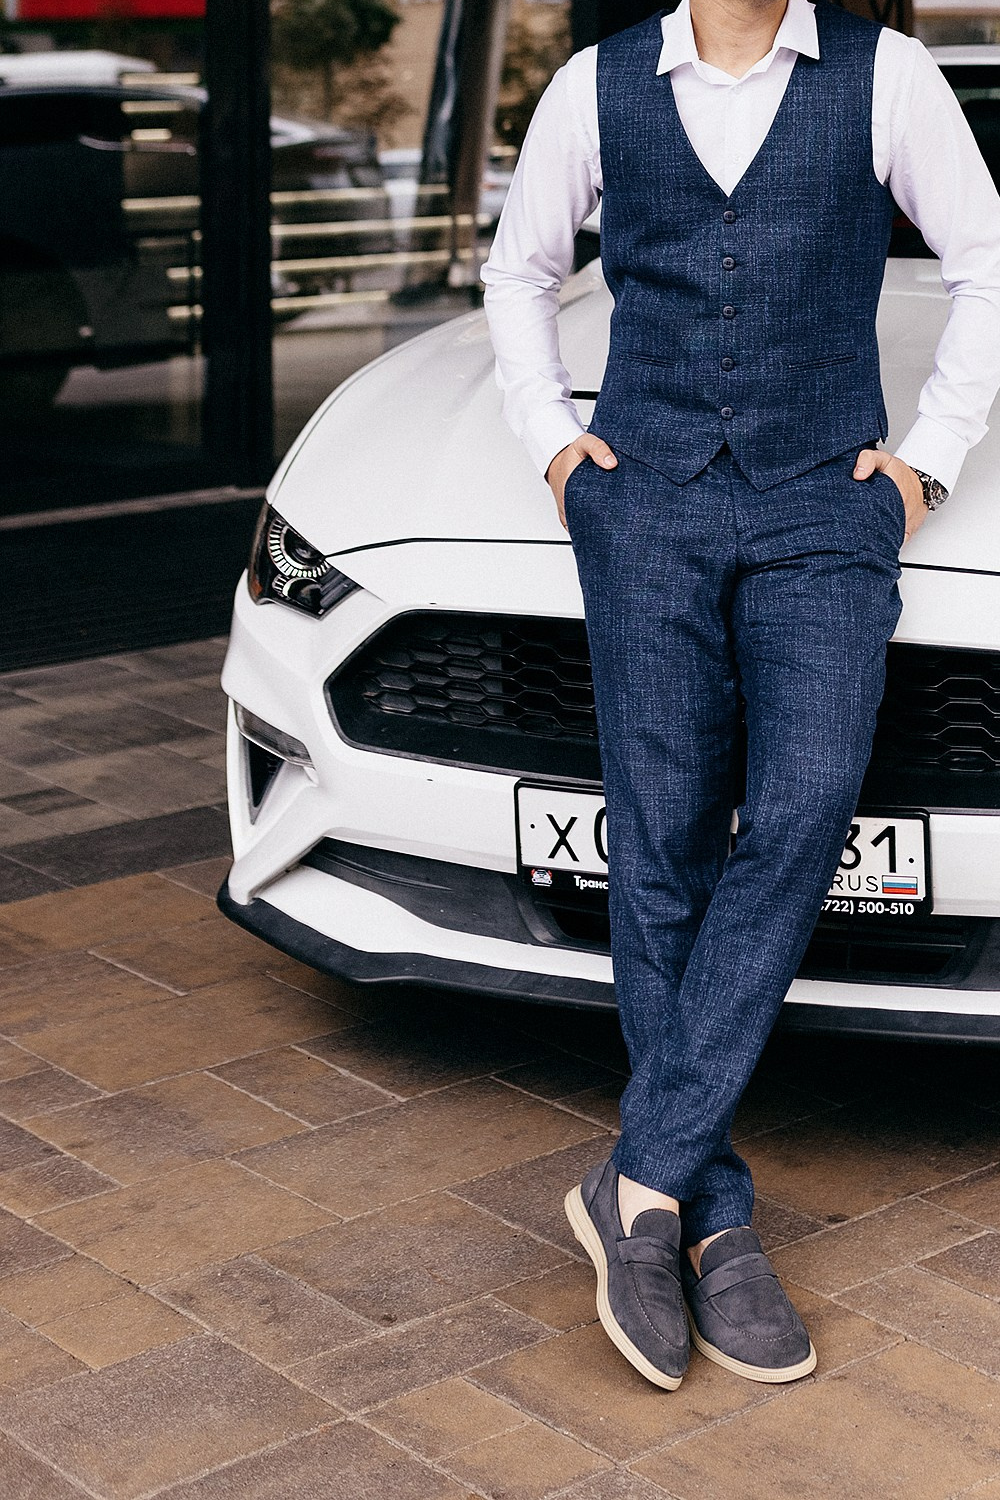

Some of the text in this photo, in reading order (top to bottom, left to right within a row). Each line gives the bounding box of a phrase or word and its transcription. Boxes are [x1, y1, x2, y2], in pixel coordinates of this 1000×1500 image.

[839, 824, 897, 873] 31
[830, 874, 878, 892] RUS
[821, 900, 914, 915] 722) 500-510
